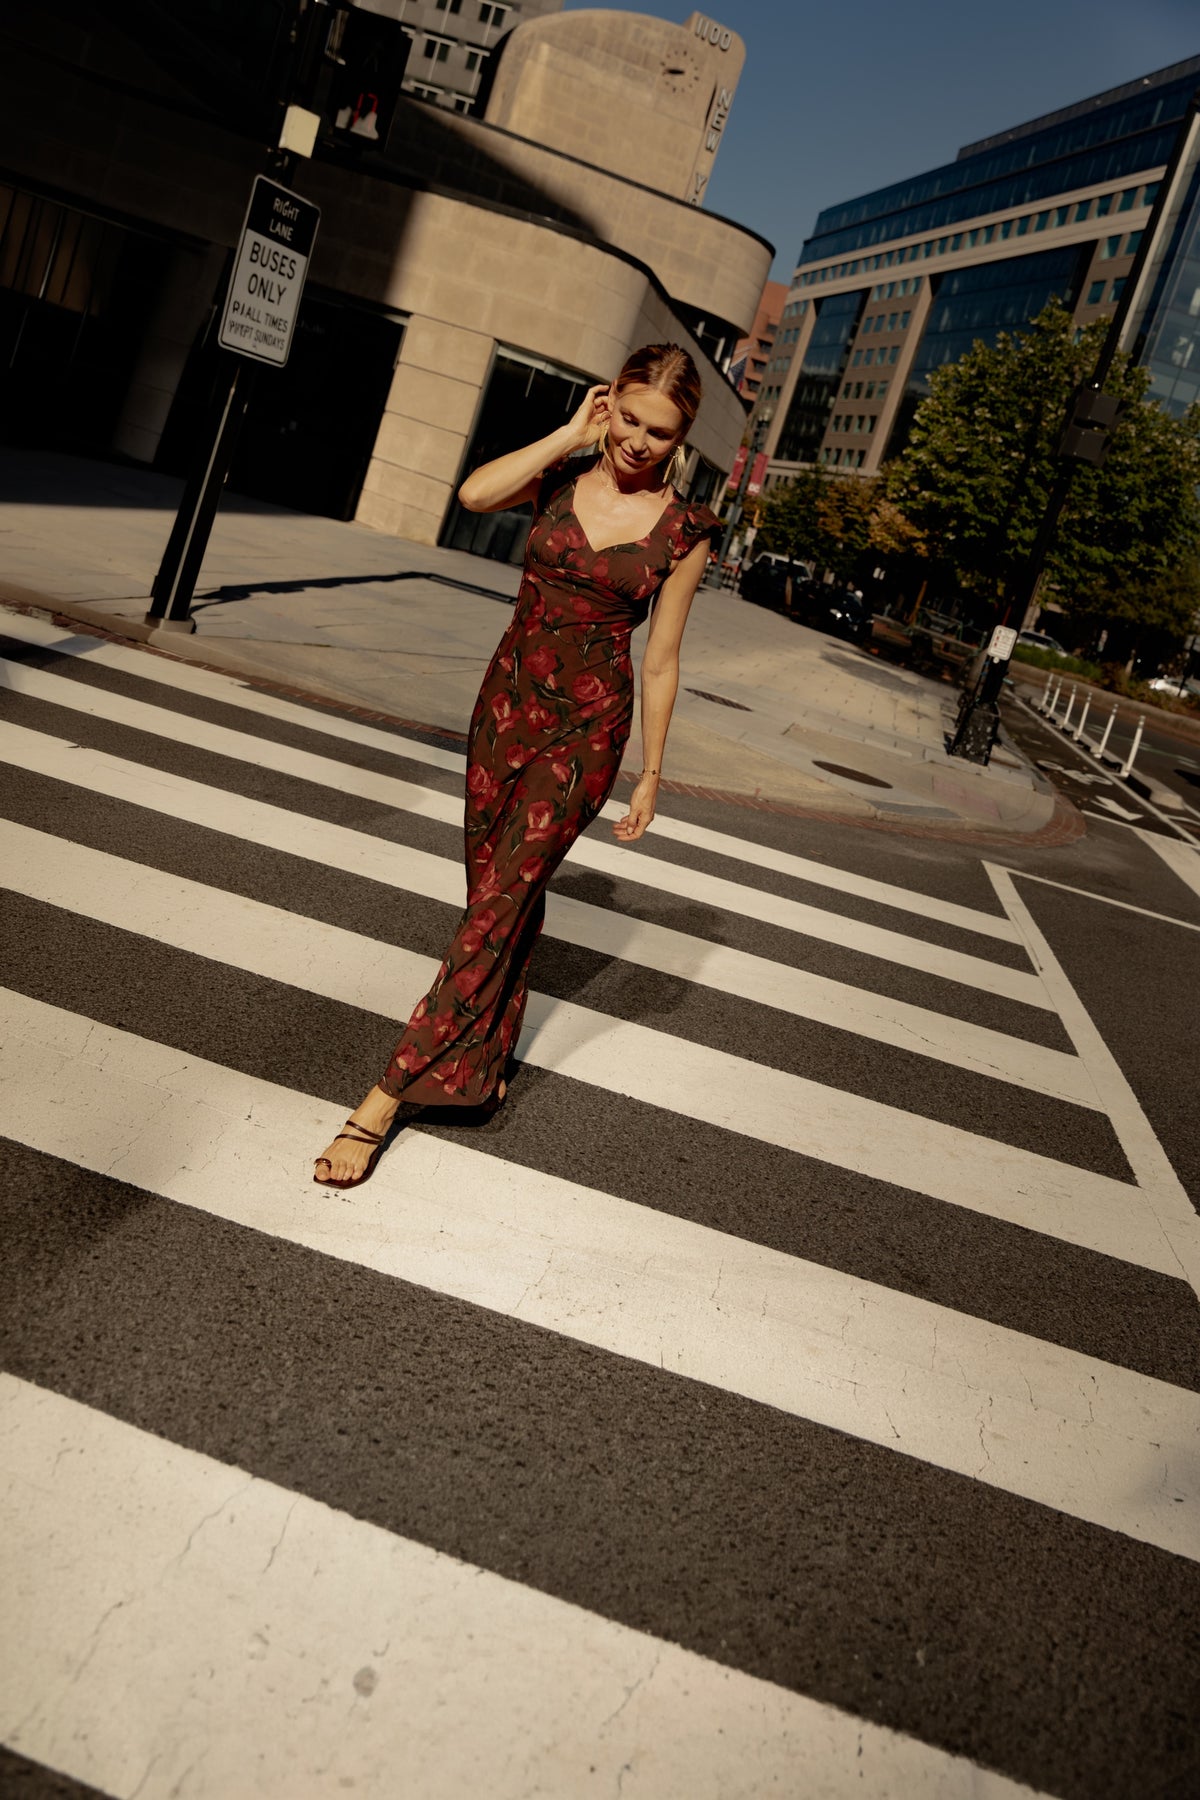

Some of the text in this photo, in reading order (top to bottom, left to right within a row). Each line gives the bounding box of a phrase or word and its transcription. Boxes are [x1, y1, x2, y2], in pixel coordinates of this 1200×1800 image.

[695, 16, 732, 51] 1100
[706, 87, 733, 153] NEW
[273, 198, 300, 222] RIGHT
[269, 219, 294, 241] LANE
[249, 241, 297, 280] BUSES
[247, 273, 287, 306] ONLY
[246, 306, 261, 324] ALL
[264, 313, 288, 333] TIMES
[254, 329, 285, 351] SUNDAYS
